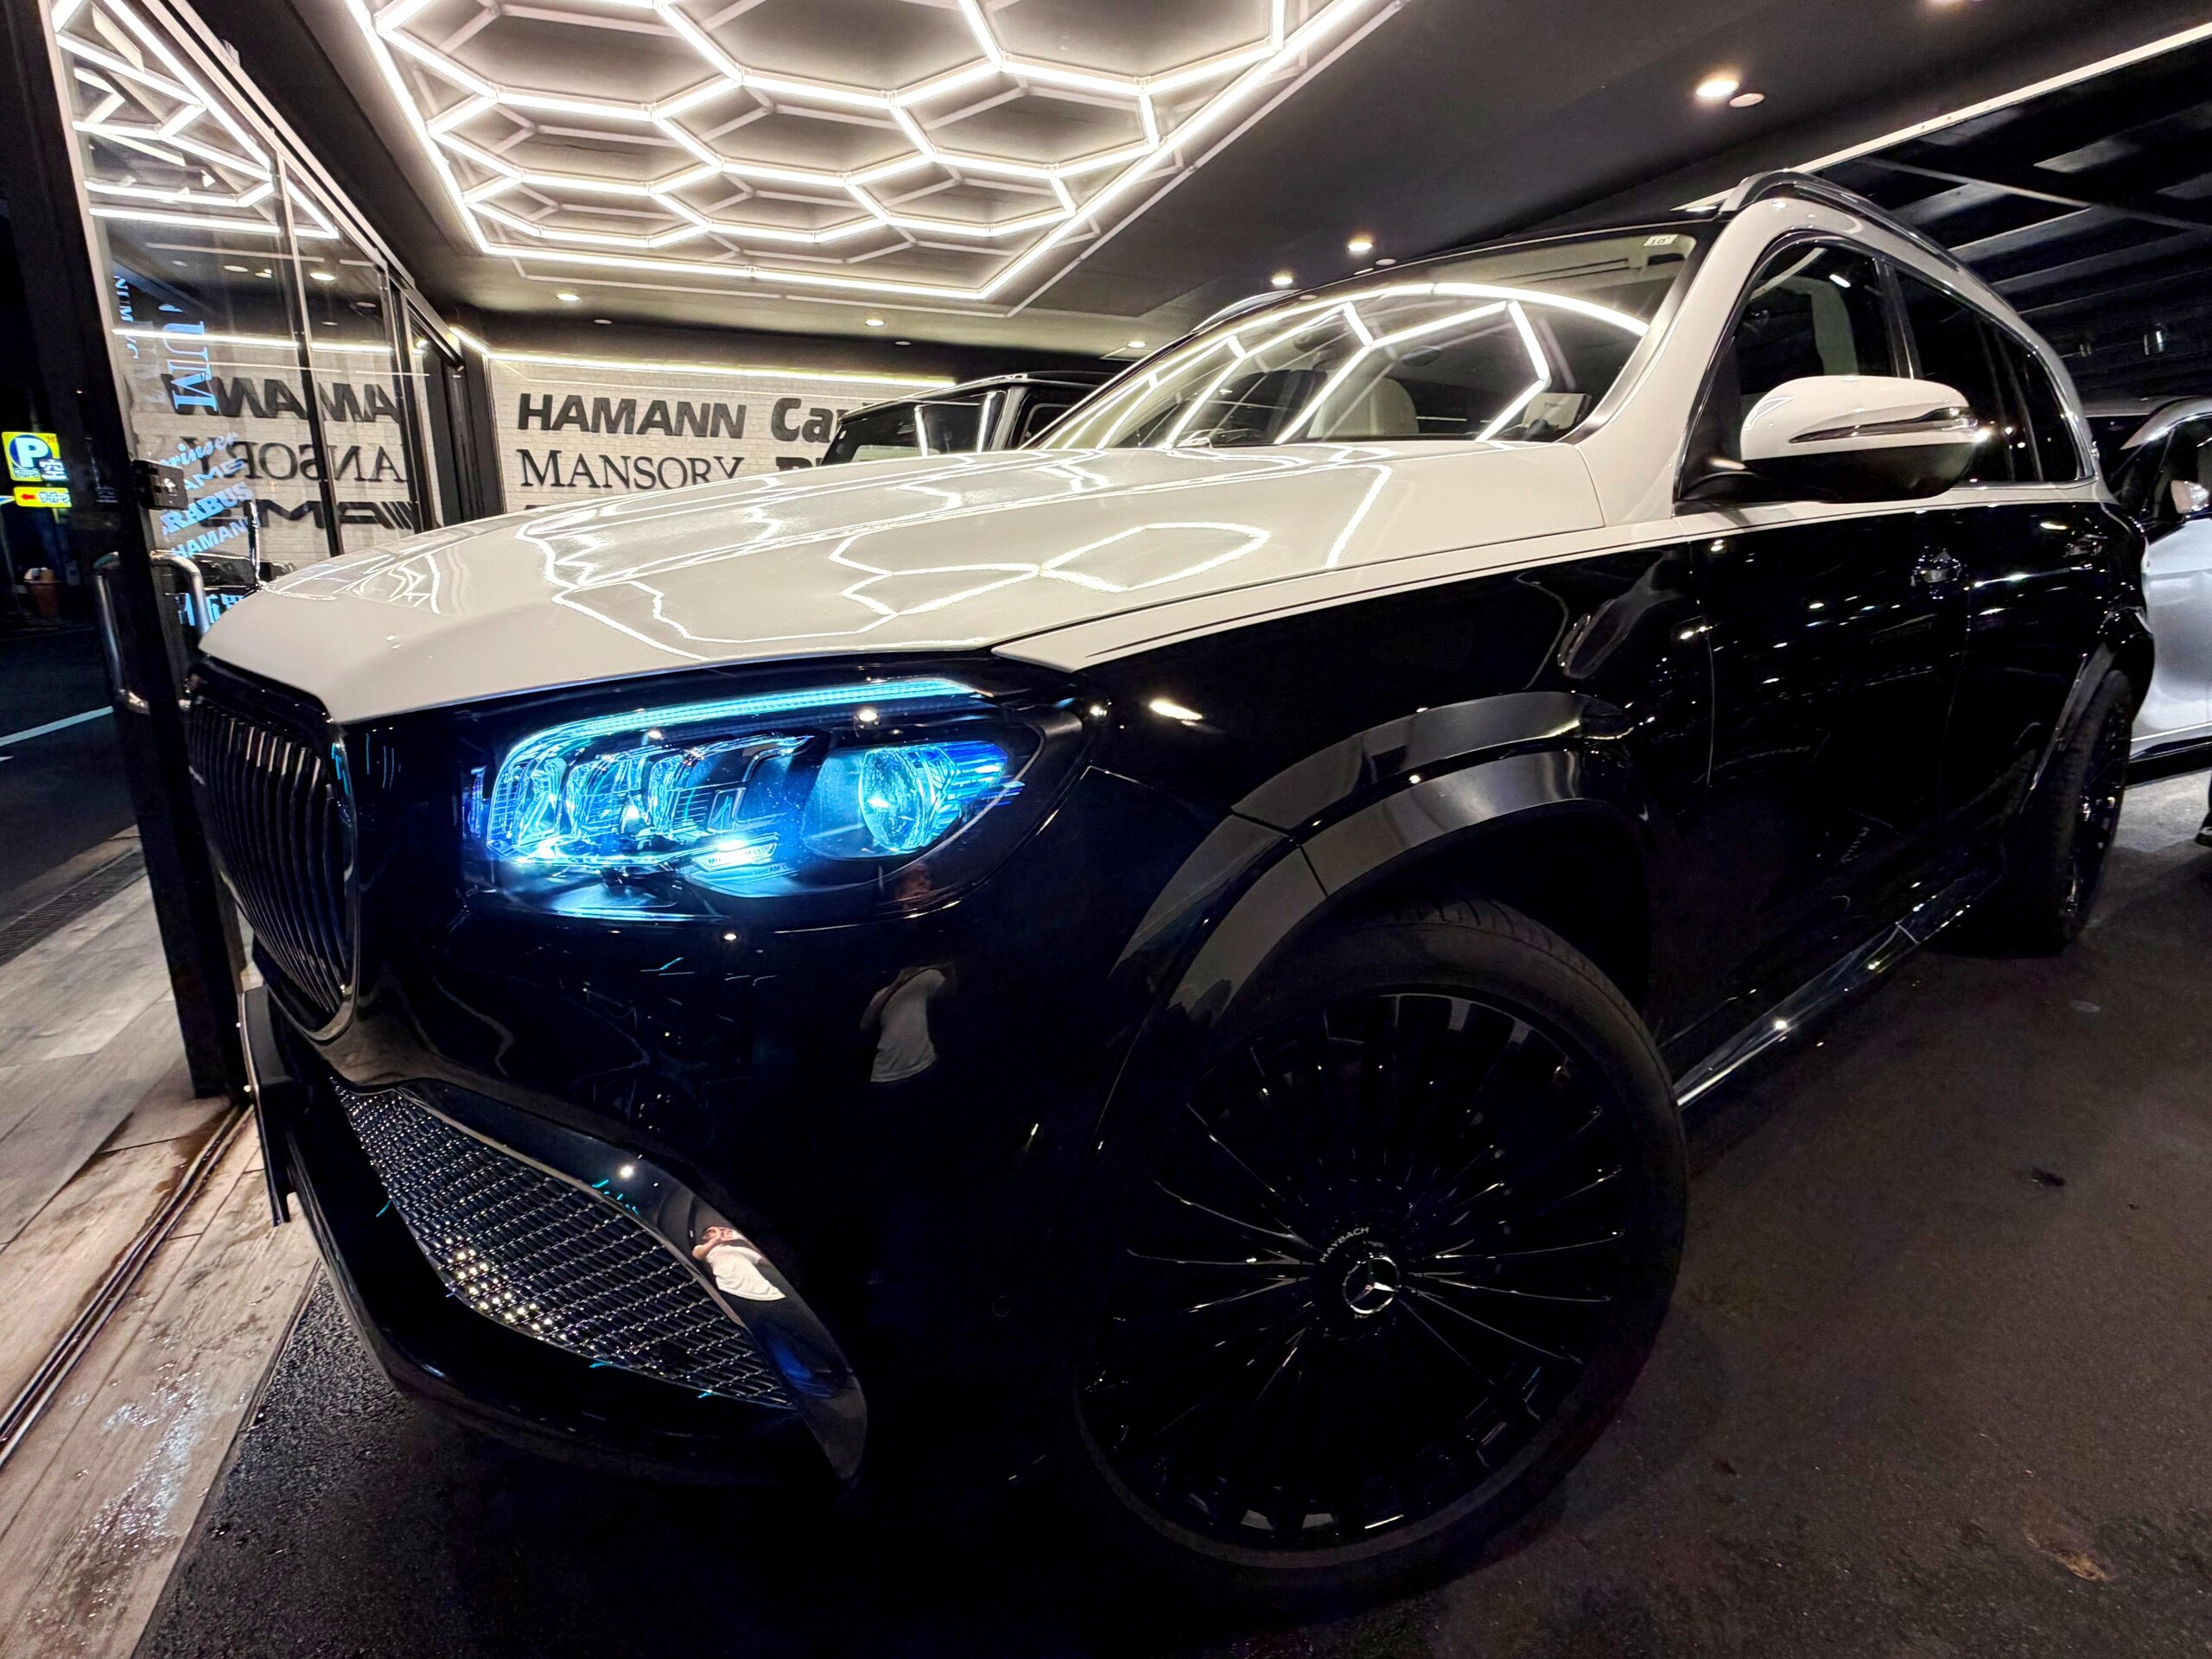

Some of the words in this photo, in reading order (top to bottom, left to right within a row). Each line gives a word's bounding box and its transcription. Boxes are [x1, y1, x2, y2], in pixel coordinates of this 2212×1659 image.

[518, 392, 747, 439] HAMANN
[15, 437, 49, 468] P
[516, 448, 745, 490] MANSORY
[1319, 1226, 1370, 1263] MAYBACH
